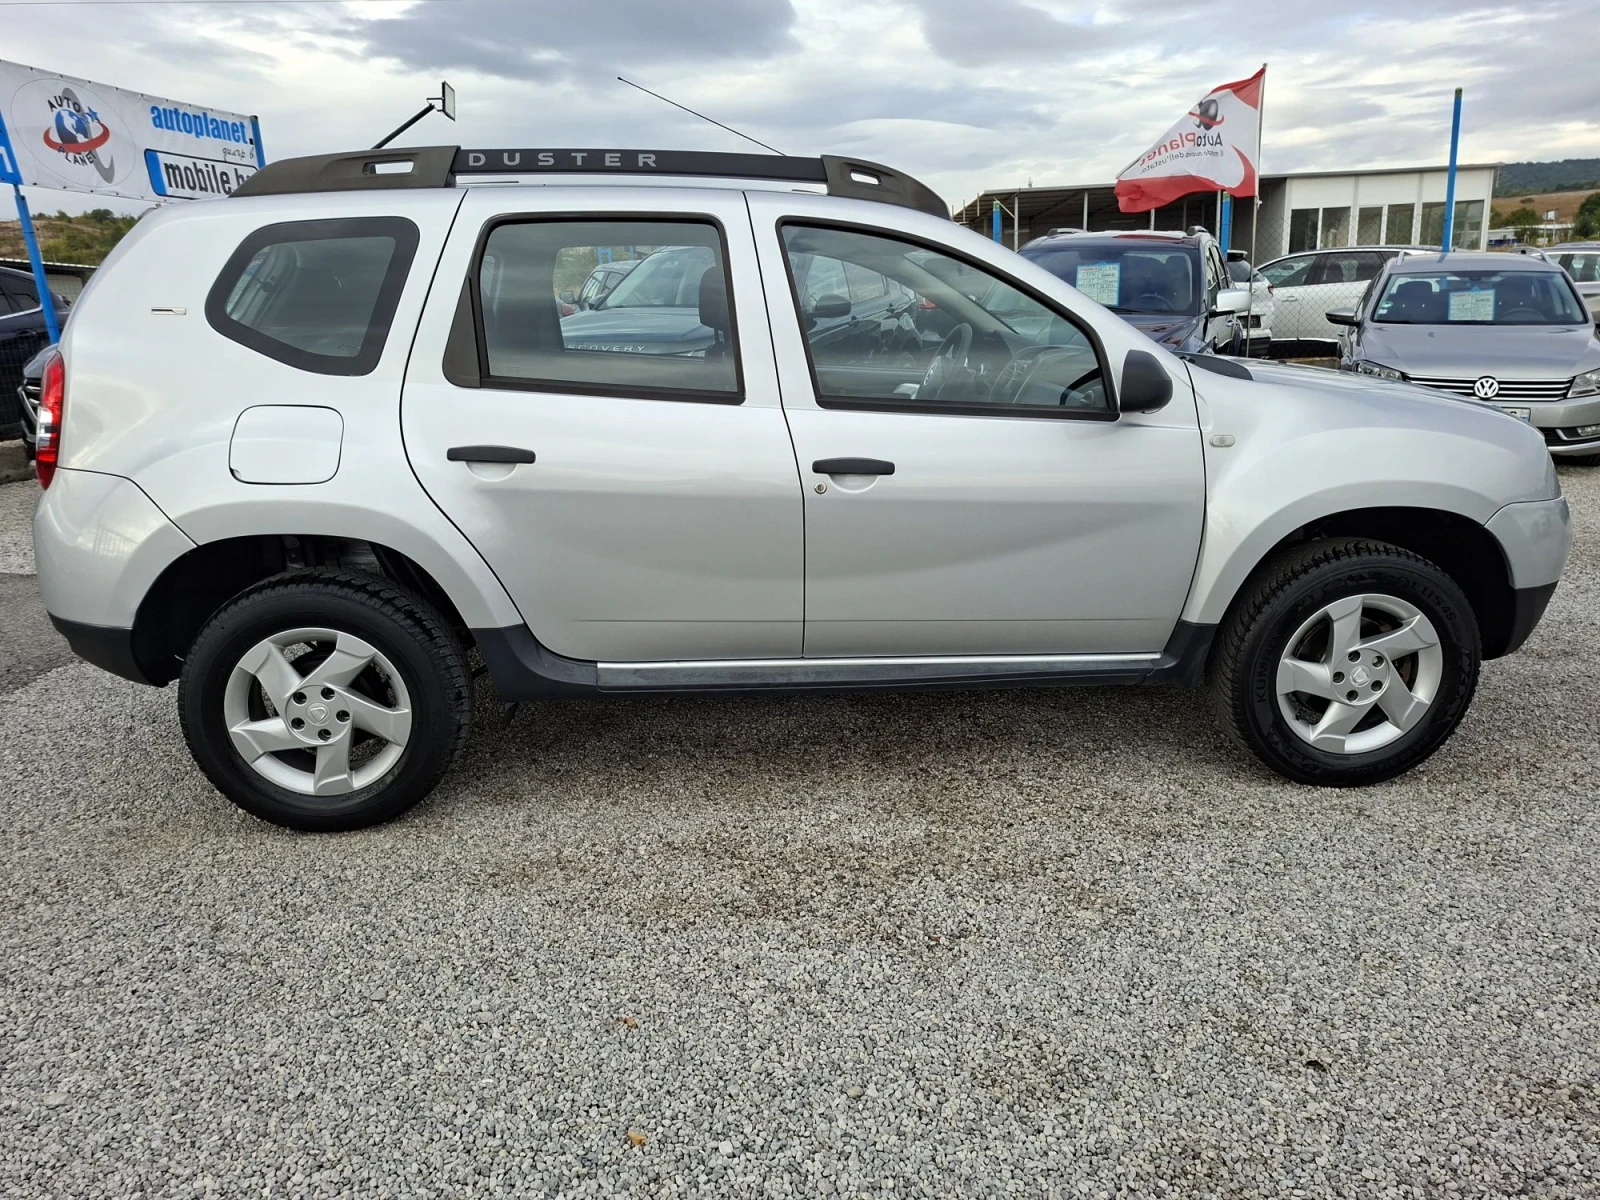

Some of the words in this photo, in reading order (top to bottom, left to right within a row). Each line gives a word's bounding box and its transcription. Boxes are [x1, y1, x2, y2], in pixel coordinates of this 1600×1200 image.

[47, 95, 82, 113] AUTO
[57, 145, 97, 167] PLANET
[468, 152, 657, 168] DUSTER
